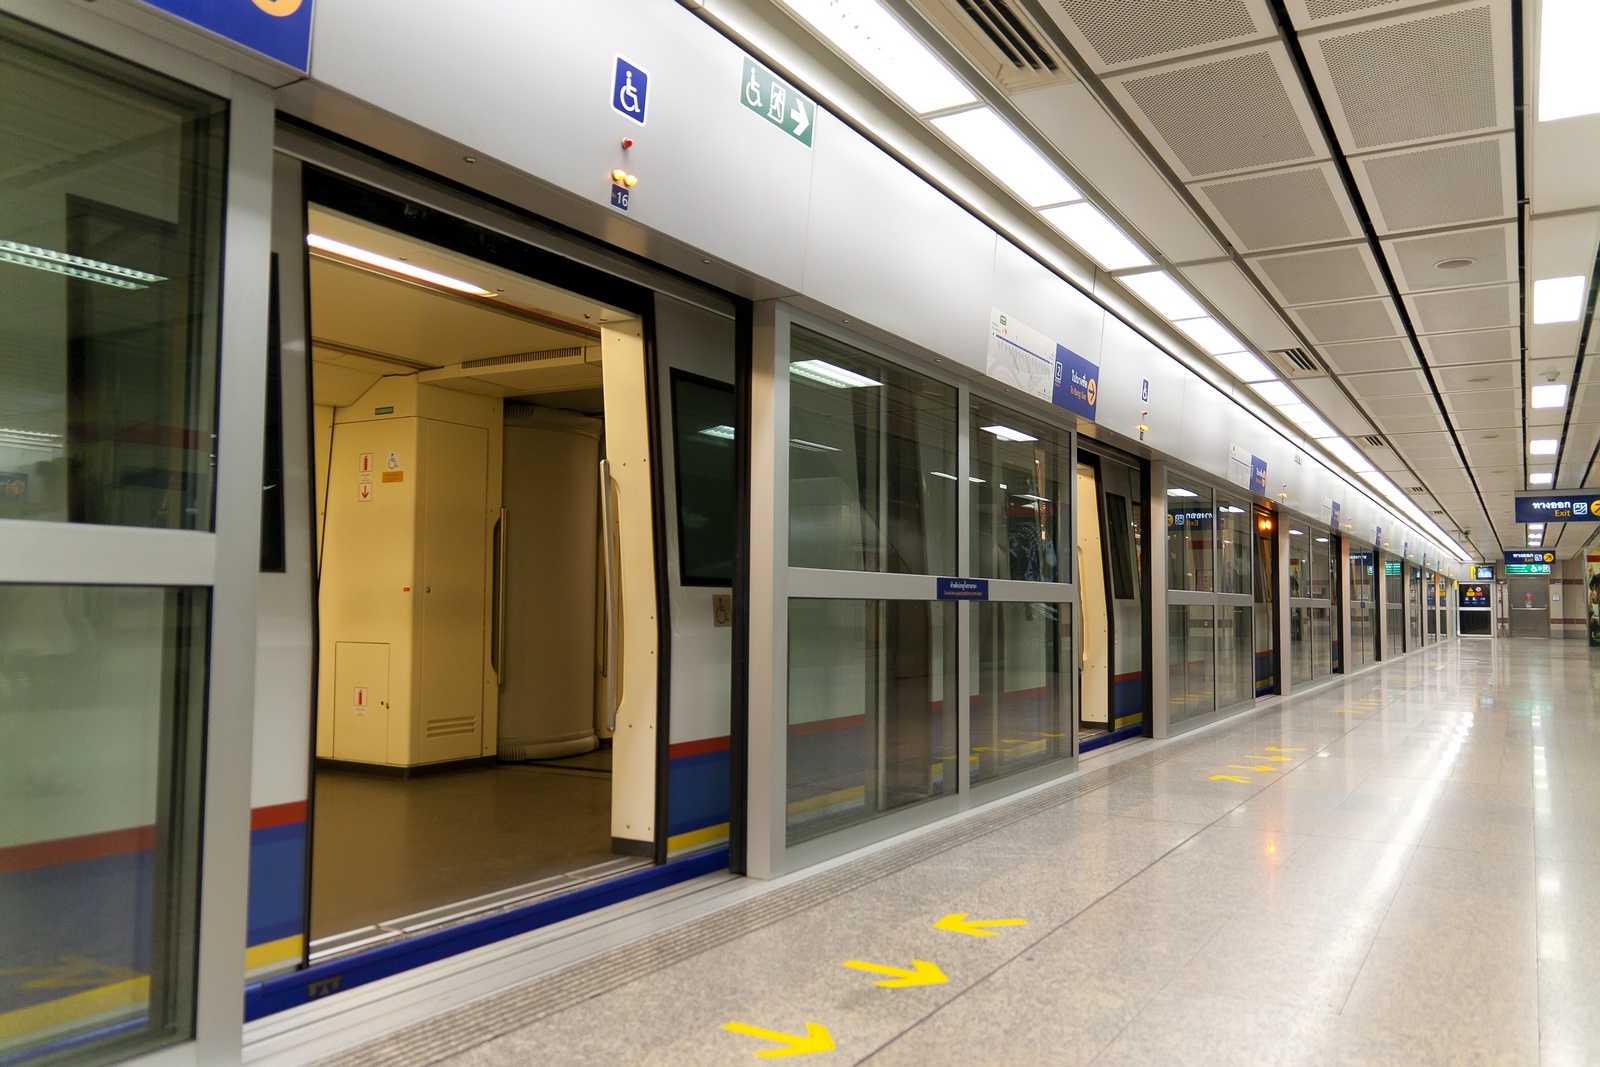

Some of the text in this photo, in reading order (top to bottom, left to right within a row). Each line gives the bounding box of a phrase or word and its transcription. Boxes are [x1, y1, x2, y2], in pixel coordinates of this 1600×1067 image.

[617, 192, 628, 207] 16
[1532, 501, 1571, 509] ทางออก
[1554, 509, 1571, 517] Exit
